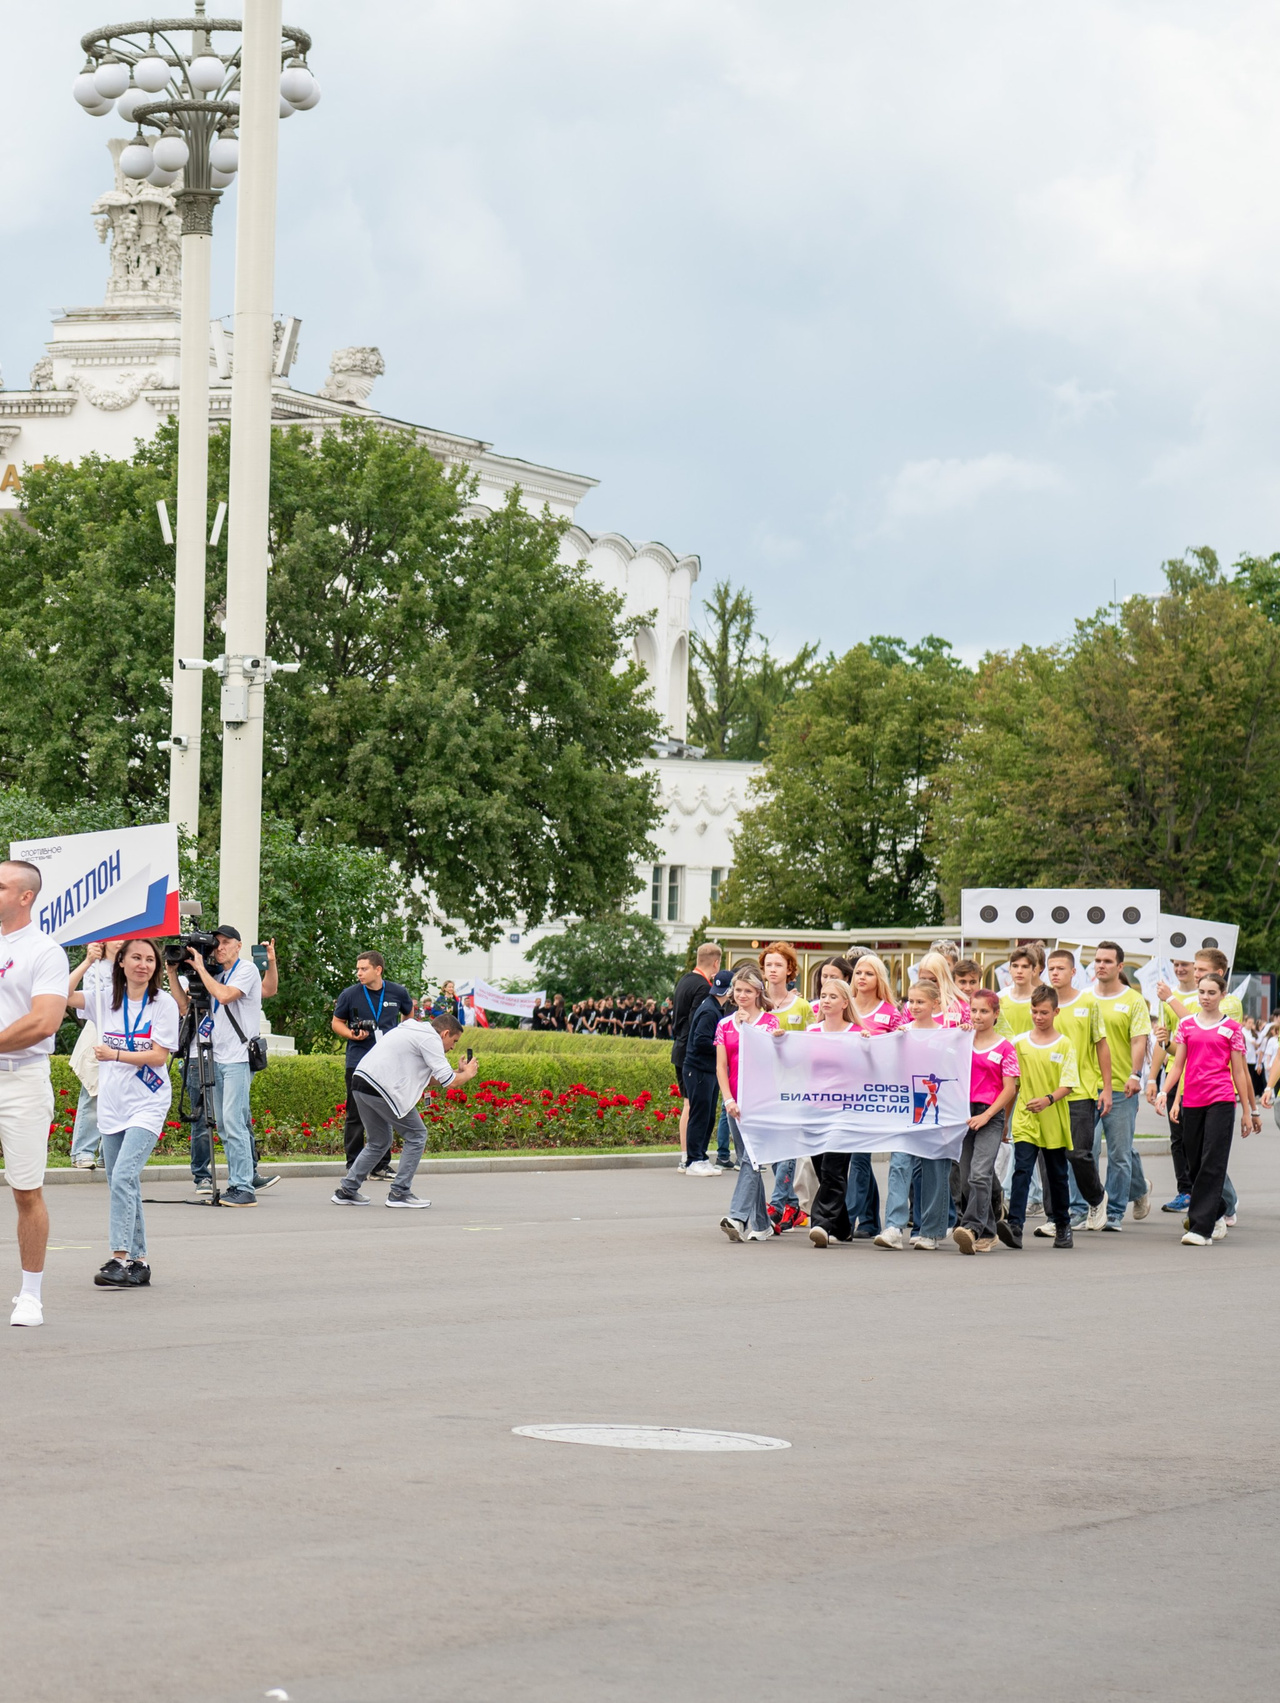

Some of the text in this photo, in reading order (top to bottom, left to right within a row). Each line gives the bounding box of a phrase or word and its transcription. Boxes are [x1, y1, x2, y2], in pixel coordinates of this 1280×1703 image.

[39, 849, 120, 936] БИАТЛОН
[863, 1083, 910, 1093] СОЮЗ
[780, 1093, 910, 1103] БИАТЛОНИСТОВ
[842, 1104, 910, 1113] РОССИИ
